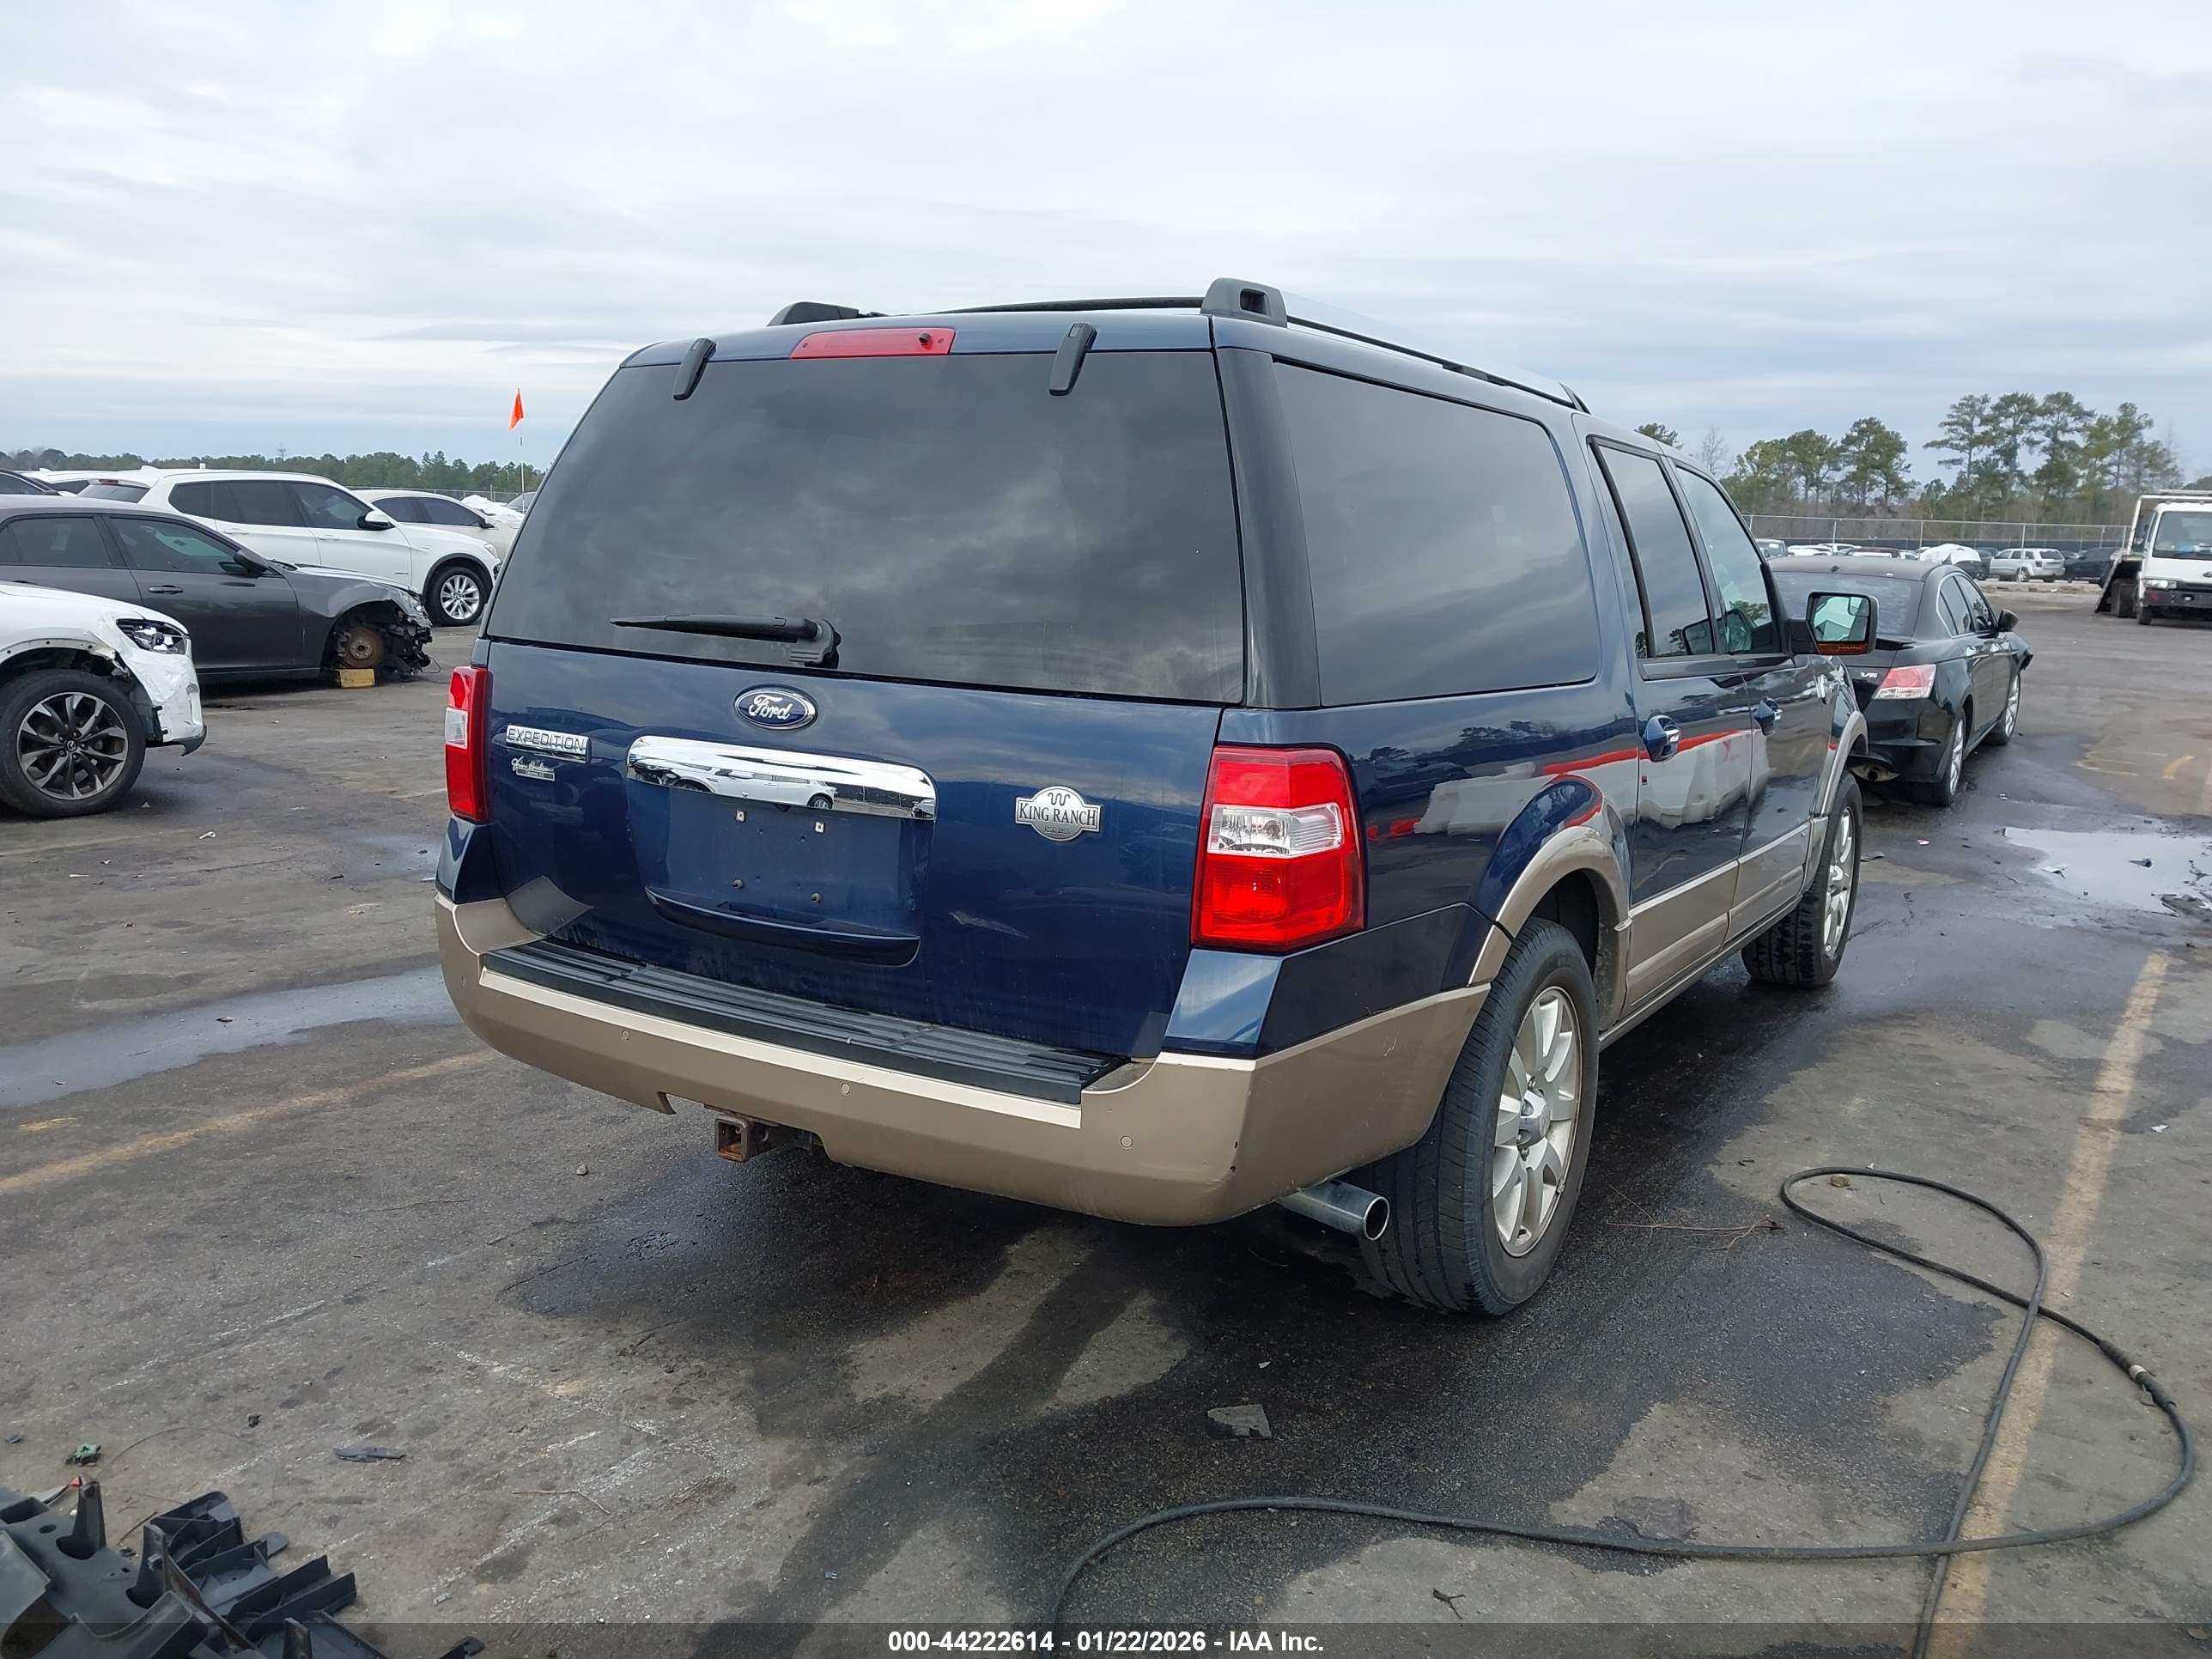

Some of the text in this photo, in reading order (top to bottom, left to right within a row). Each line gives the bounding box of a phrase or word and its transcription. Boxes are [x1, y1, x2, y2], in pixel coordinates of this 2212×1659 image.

[748, 694, 793, 720] Ford
[506, 727, 586, 752] EXPEDITION
[1018, 802, 1097, 826] KING RANCH
